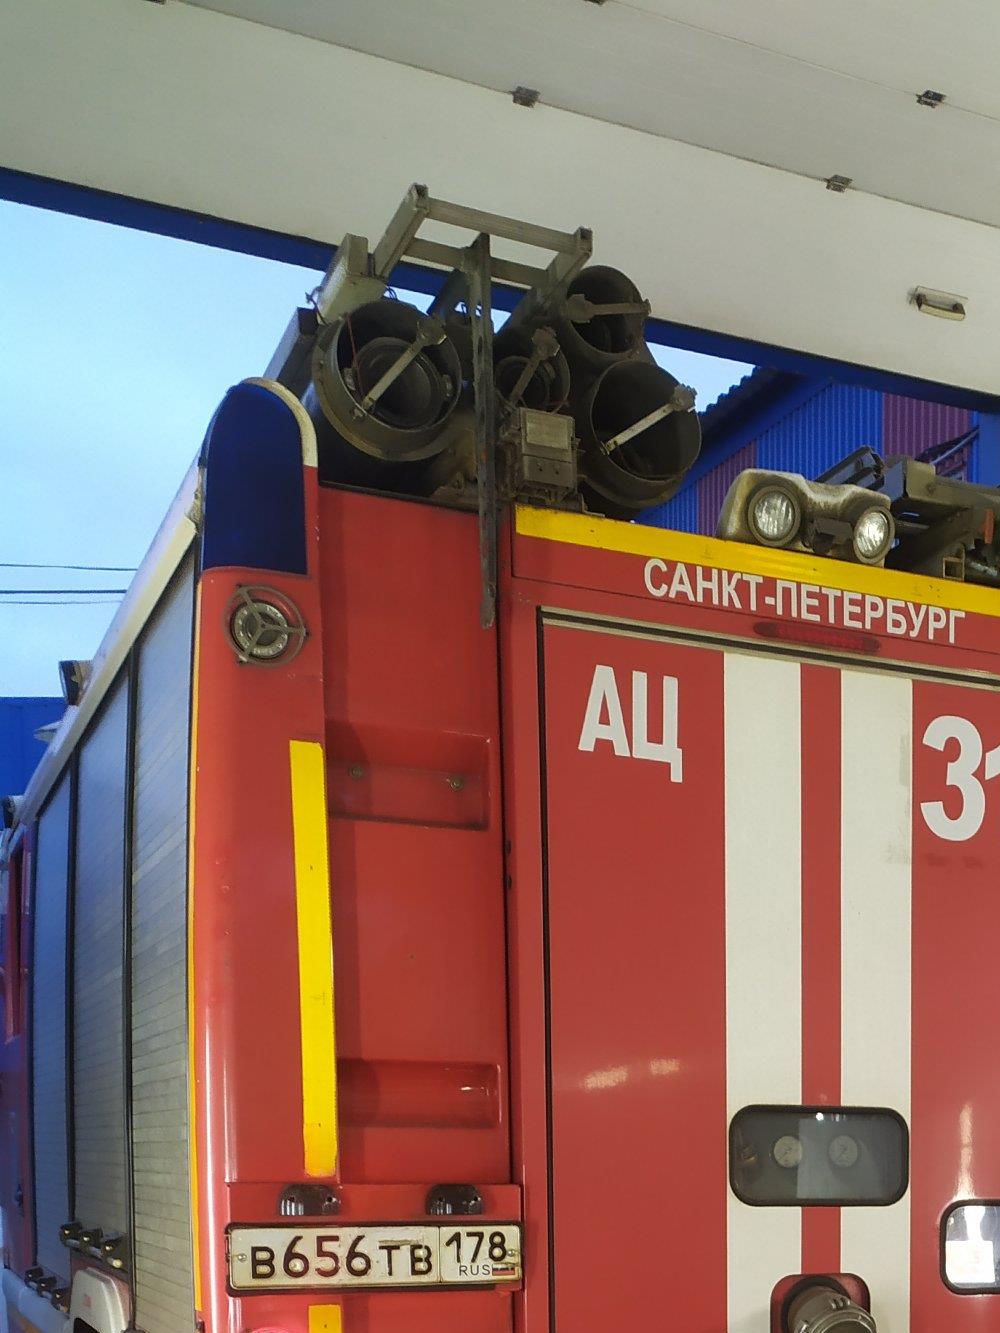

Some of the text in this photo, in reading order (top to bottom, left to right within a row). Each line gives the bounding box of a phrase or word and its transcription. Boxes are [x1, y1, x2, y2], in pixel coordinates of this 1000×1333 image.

[643, 558, 965, 644] САНКТ-ПЕТЕРБУРГ
[578, 664, 683, 783] АЦ
[251, 1231, 507, 1280] В656ТВ 178
[459, 1265, 490, 1277] RUS
